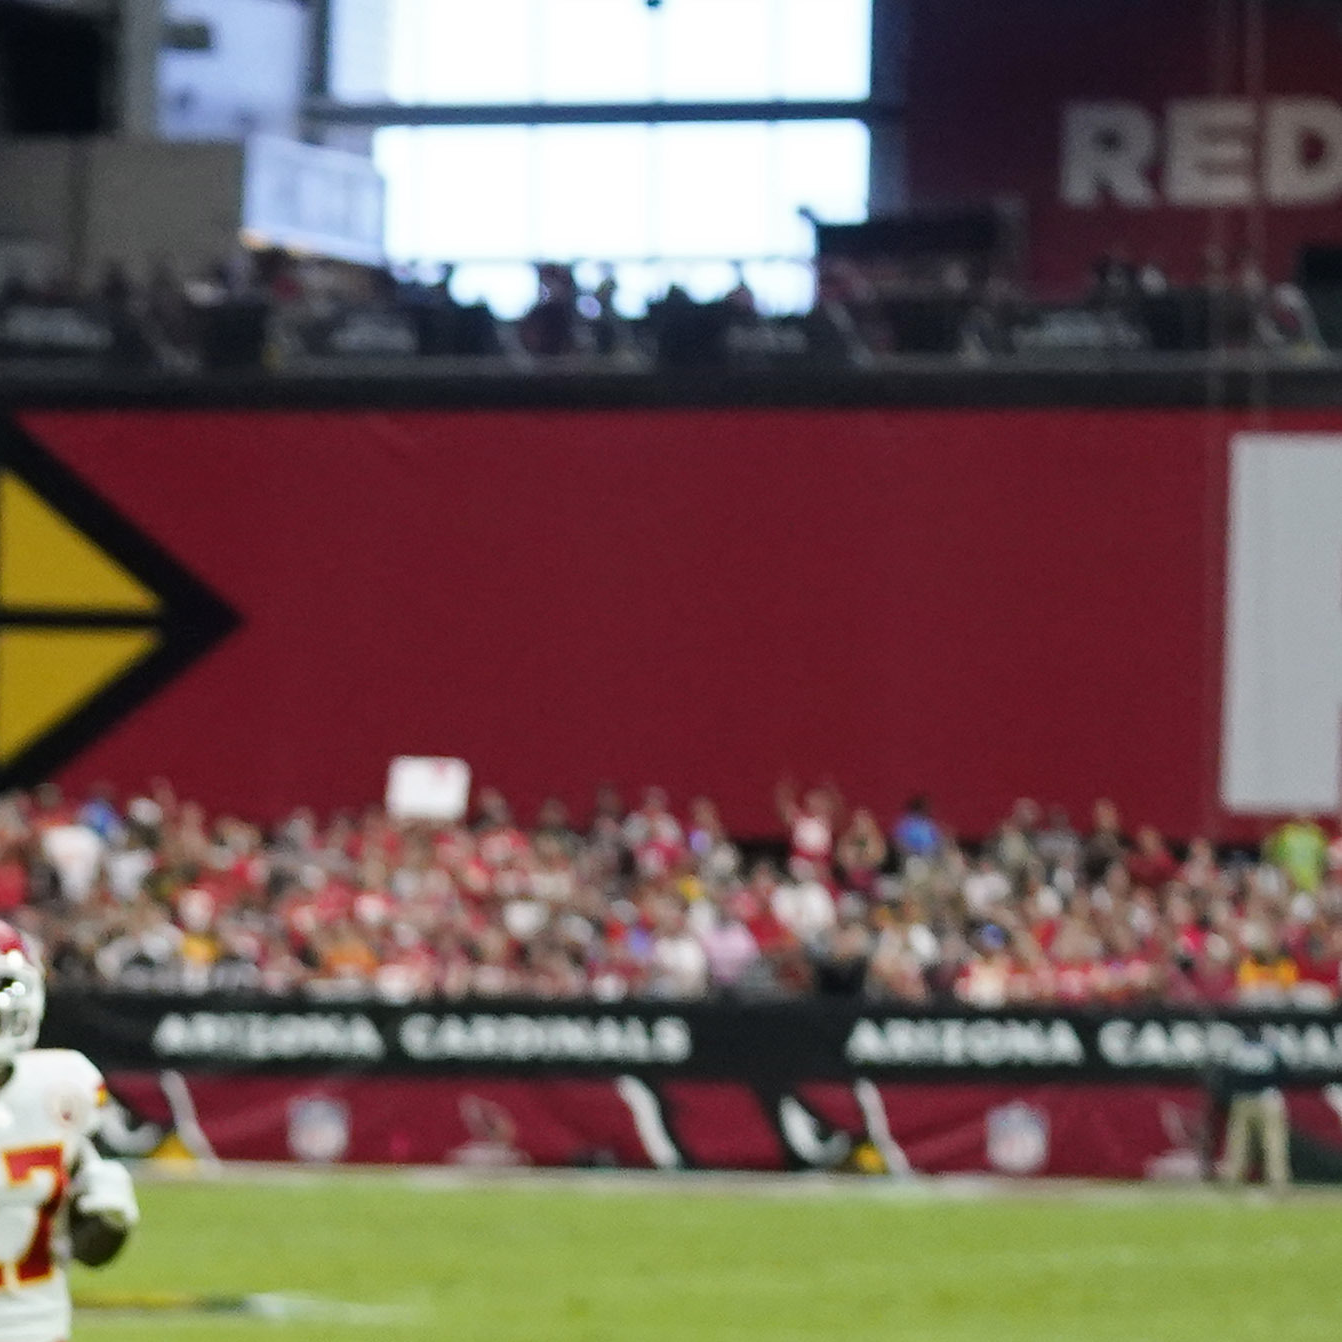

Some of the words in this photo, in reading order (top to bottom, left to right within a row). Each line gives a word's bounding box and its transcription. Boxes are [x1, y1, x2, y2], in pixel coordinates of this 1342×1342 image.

[1059, 100, 1342, 207] RED
[153, 1011, 385, 1062] ARIZONA
[398, 1014, 692, 1065] CARDINALS
[846, 1017, 1085, 1067] ARIZONA
